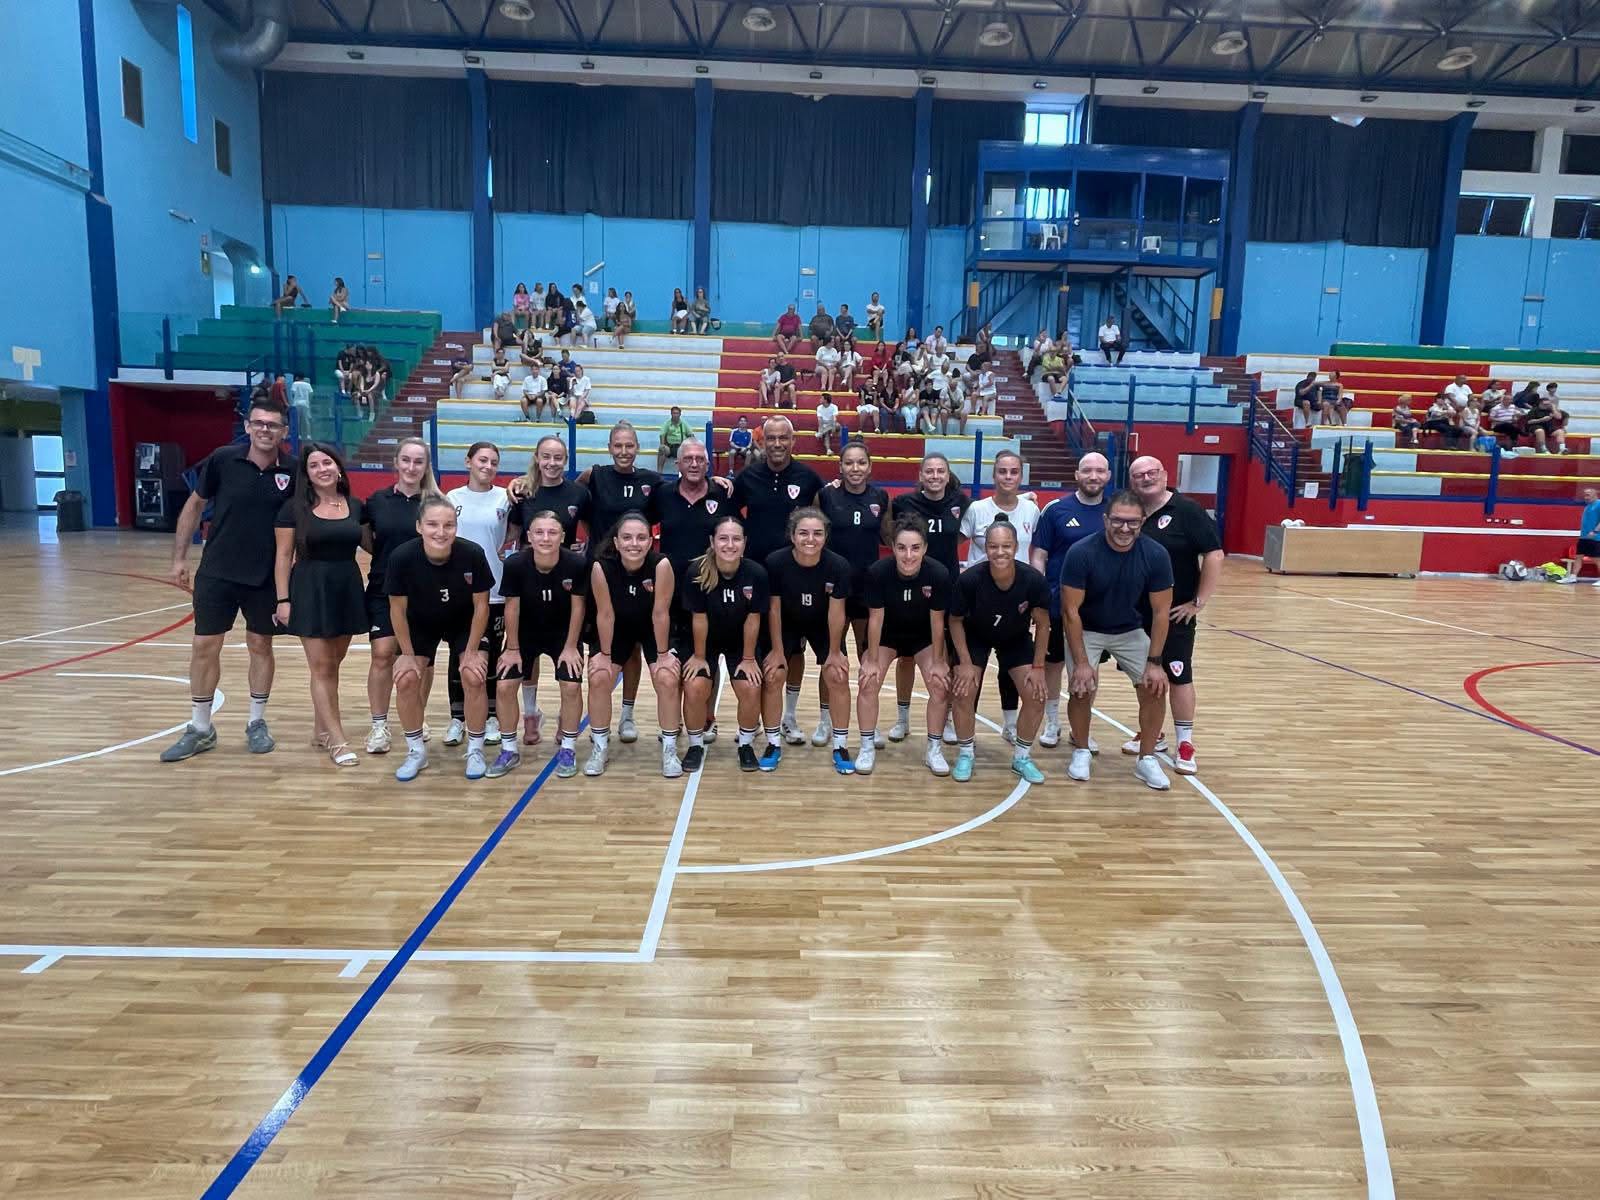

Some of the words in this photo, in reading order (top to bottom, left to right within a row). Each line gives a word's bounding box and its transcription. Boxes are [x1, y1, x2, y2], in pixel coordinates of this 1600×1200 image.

[623, 485, 634, 498] 17
[853, 511, 862, 525] 8
[927, 518, 943, 533] 21
[439, 588, 450, 602] 3
[541, 589, 552, 602] 11
[628, 584, 636, 596] 4
[723, 588, 735, 603] 14
[903, 589, 912, 602] 11
[801, 593, 813, 606] 19
[993, 614, 1002, 627] 7
